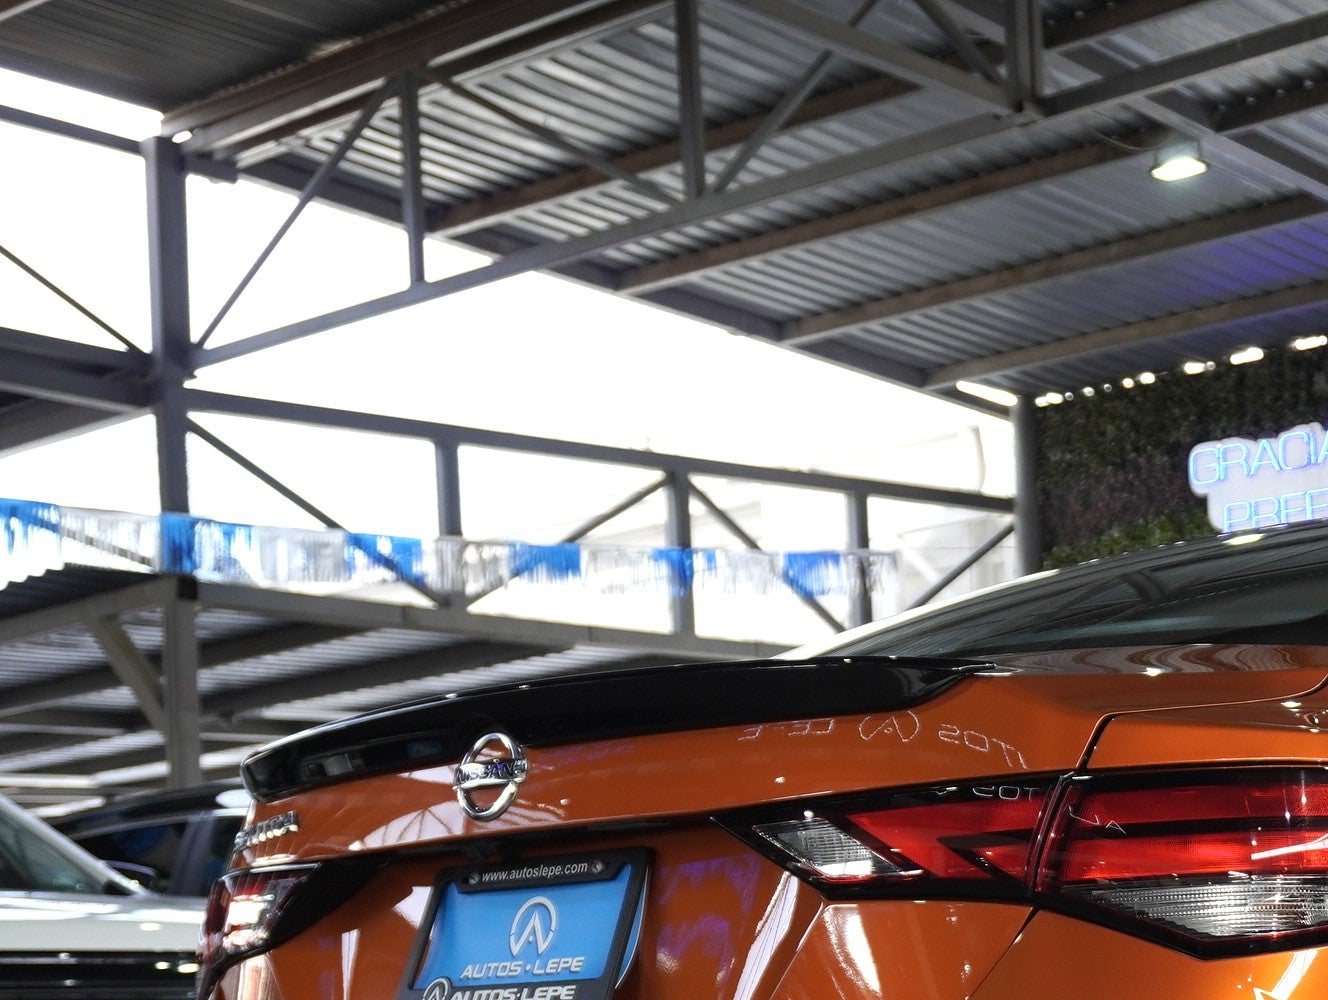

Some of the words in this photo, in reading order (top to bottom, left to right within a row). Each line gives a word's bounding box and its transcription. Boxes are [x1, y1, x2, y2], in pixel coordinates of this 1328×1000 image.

[481, 860, 588, 883] www.autoslepe.com
[459, 959, 522, 980] AUTOS
[532, 955, 585, 975] LEPE
